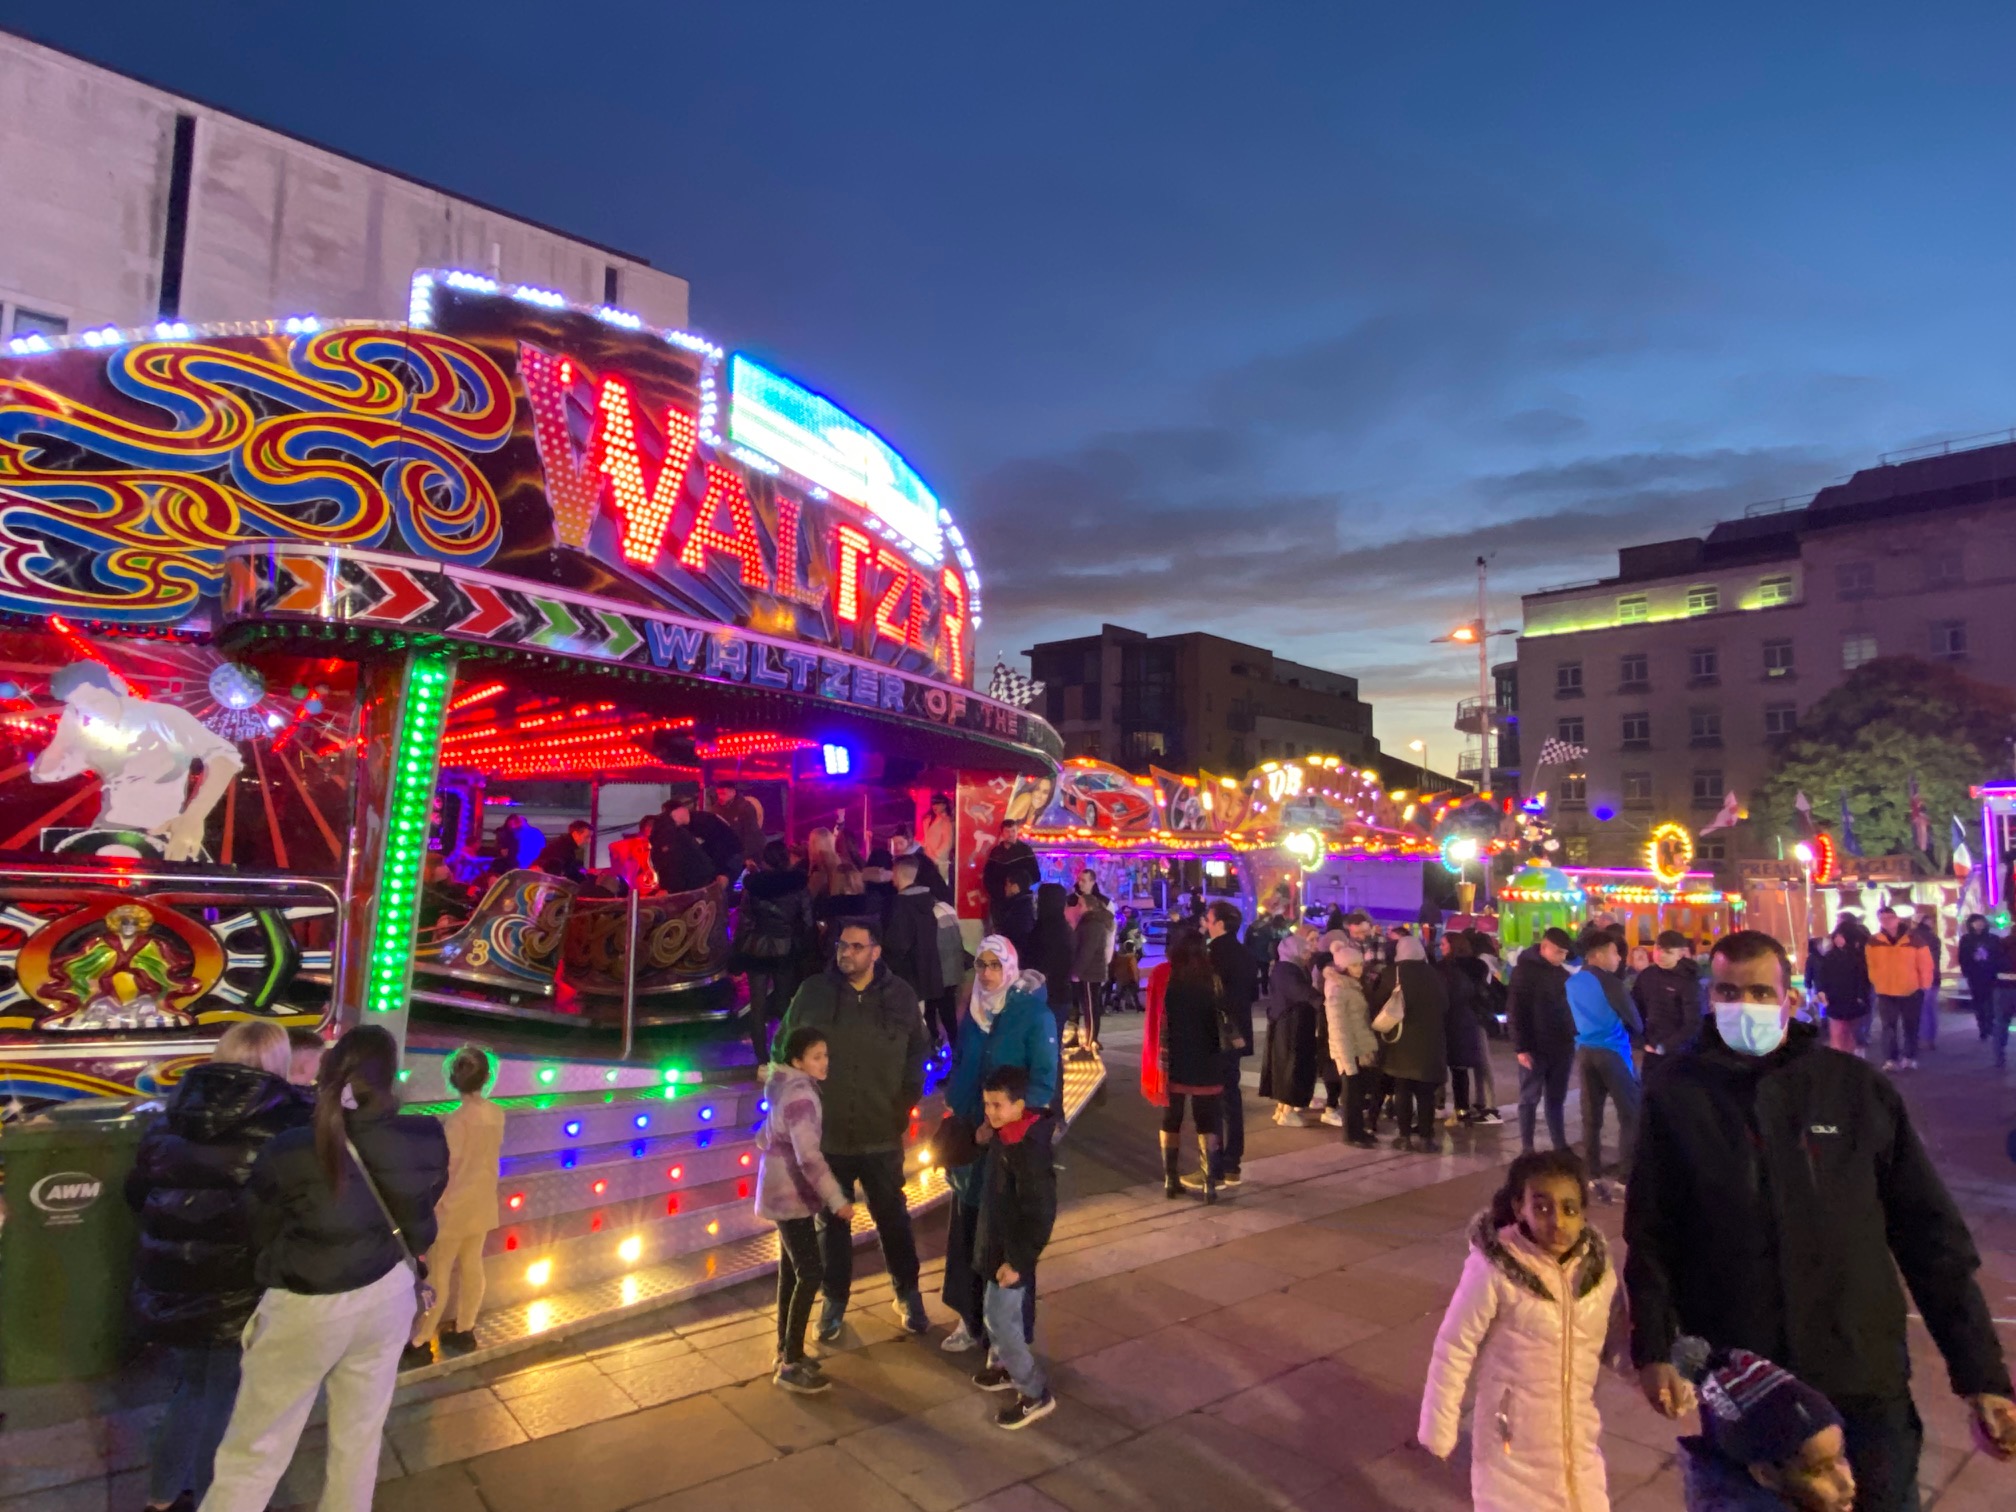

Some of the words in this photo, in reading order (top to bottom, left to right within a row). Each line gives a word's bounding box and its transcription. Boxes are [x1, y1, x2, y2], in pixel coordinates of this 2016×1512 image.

[516, 338, 966, 684] WALTZER
[644, 620, 906, 712] WALTZER
[925, 688, 967, 726] OF
[980, 702, 1018, 736] THE
[1740, 862, 1806, 877] PREMI
[465, 938, 490, 967] 3
[45, 1181, 101, 1200] AWM
